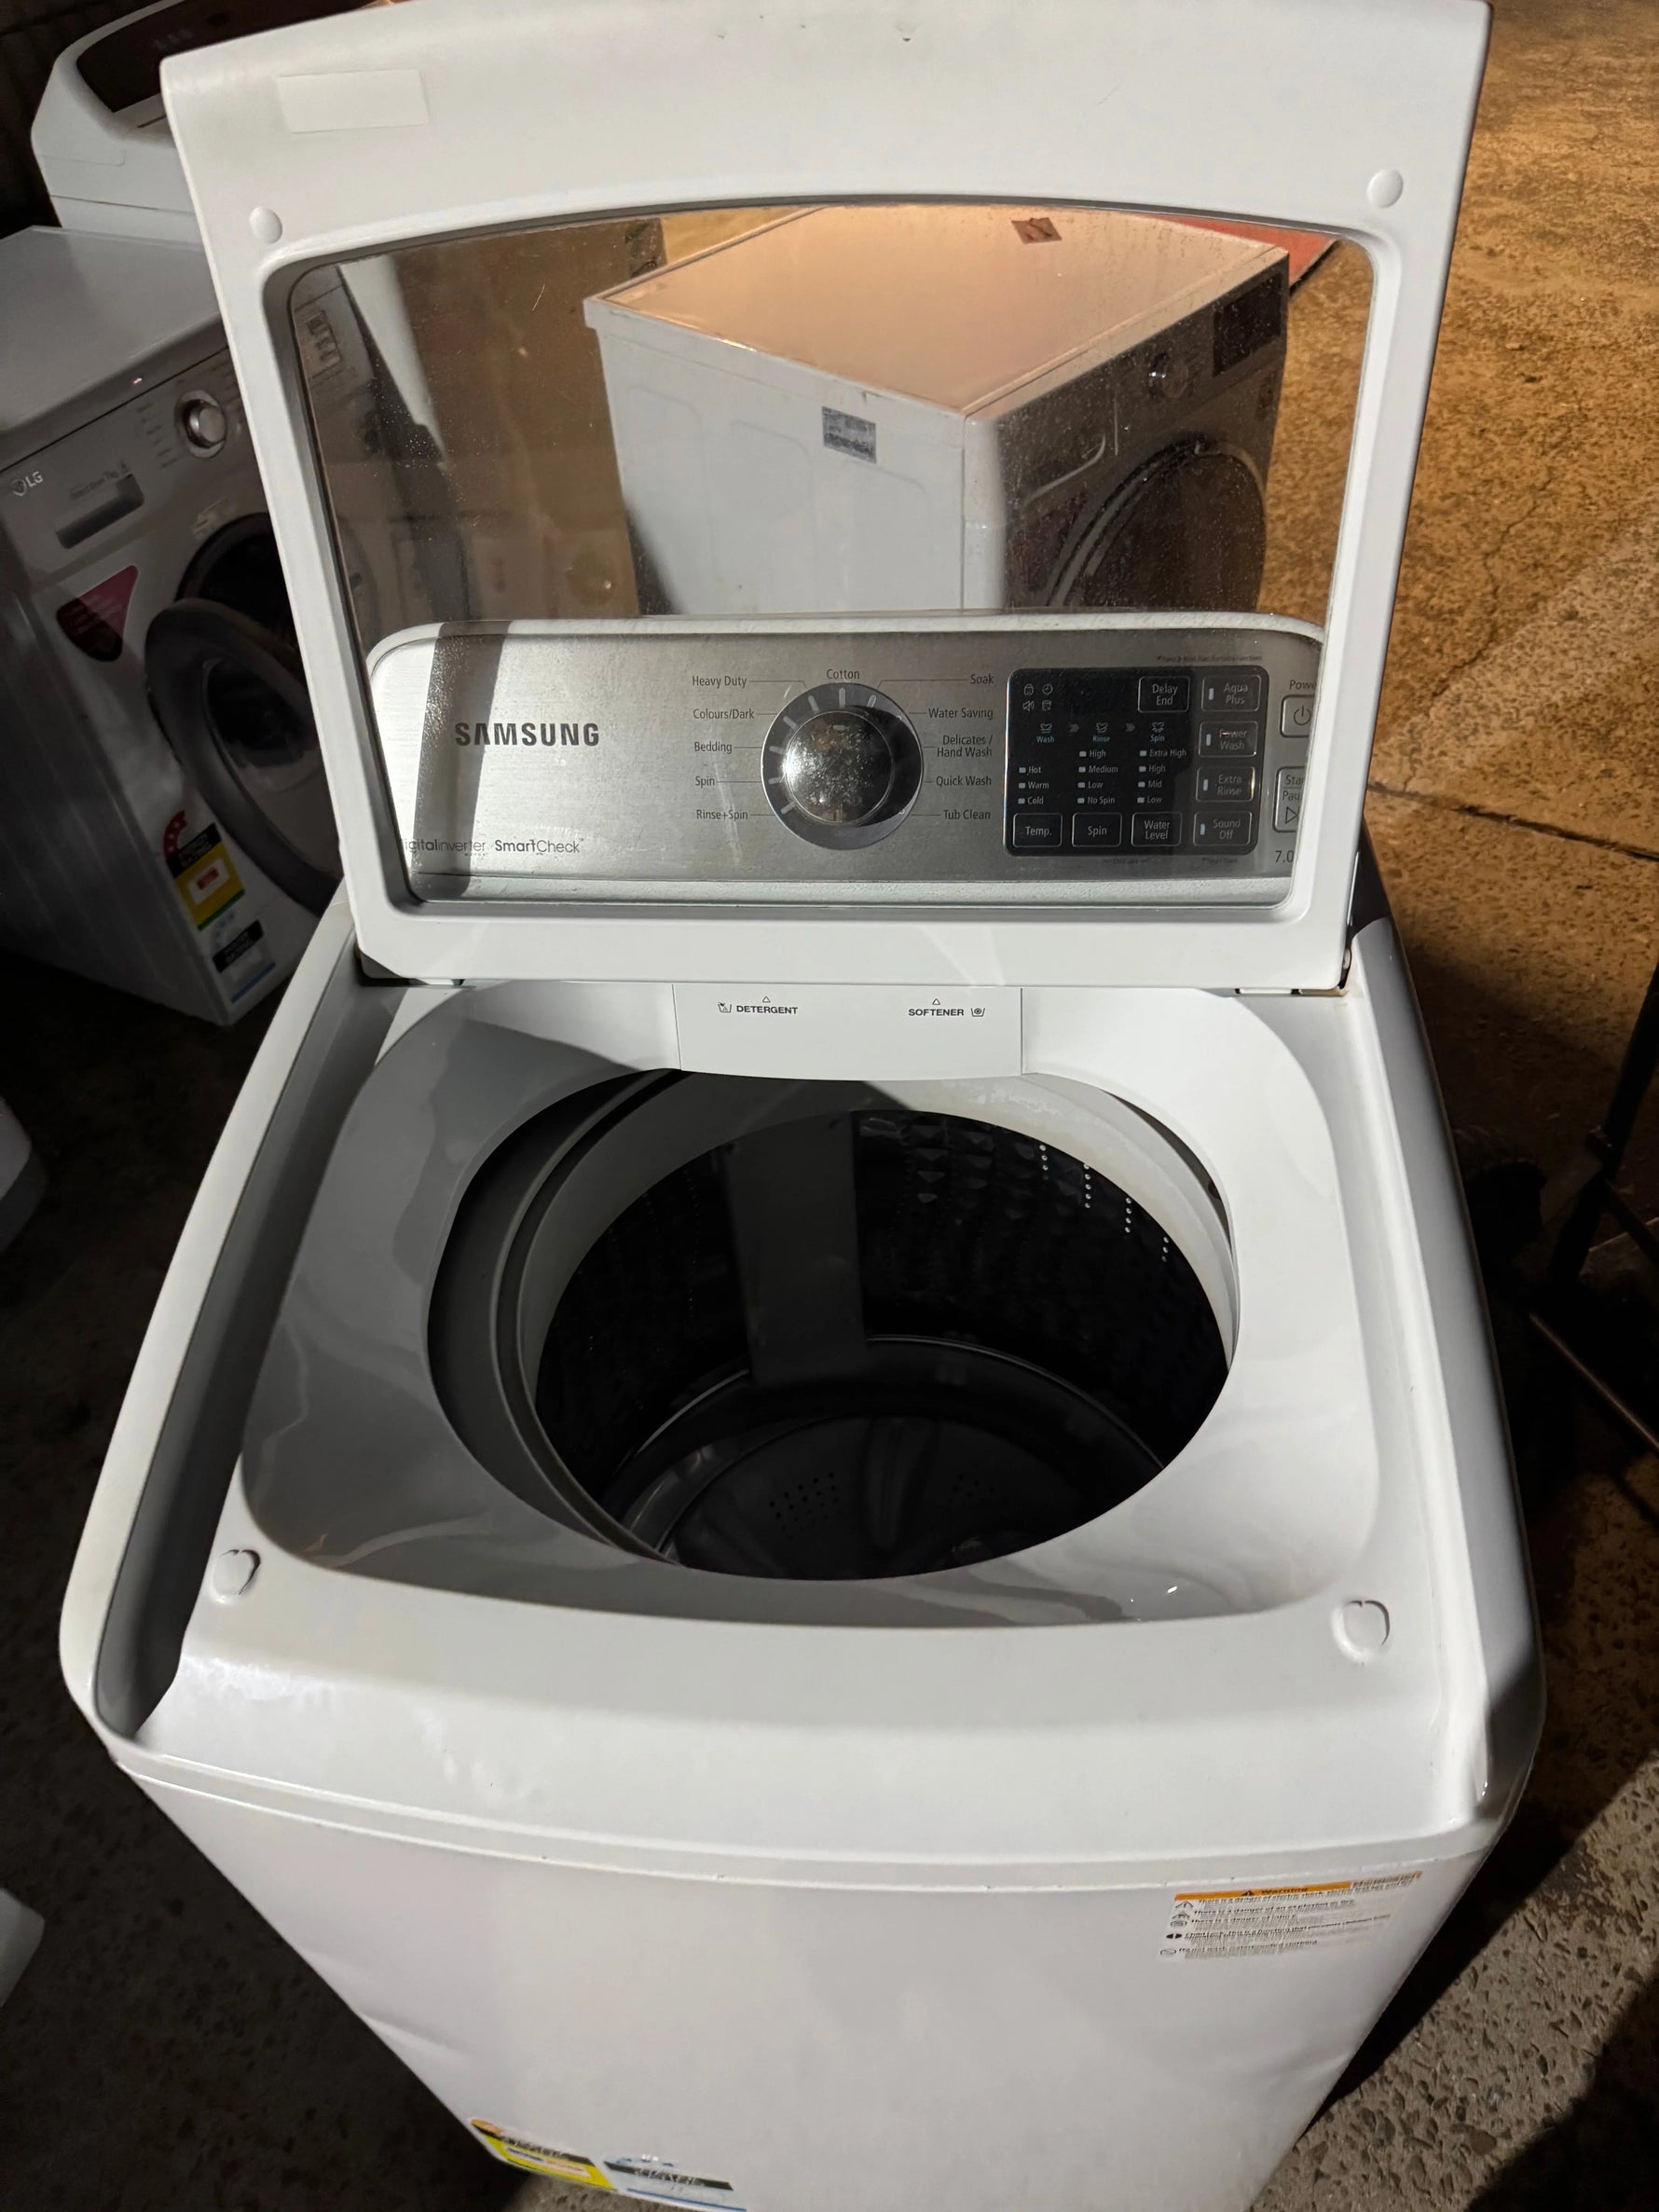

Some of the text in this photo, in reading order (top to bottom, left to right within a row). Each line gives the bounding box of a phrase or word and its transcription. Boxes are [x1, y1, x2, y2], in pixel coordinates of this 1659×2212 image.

[25, 471, 44, 488] LG
[826, 668, 860, 680] Cotton
[970, 674, 994, 684] Soak
[692, 675, 747, 688] Heavy Duty
[1289, 679, 1316, 690] Powe
[1151, 683, 1178, 695] Delay
[1223, 683, 1249, 694] Aqua
[1156, 695, 1173, 706] End
[1226, 695, 1246, 705] Plus
[692, 708, 755, 720] Colours/Dark
[928, 708, 994, 721] Water Saving
[455, 722, 599, 747] SAMSUNG
[1219, 729, 1248, 738] Power
[942, 735, 986, 745] Delicates
[1092, 735, 1110, 743] Rinse
[1150, 735, 1165, 744] Spin
[694, 741, 733, 754] Bedding
[1220, 740, 1245, 750] Wash
[937, 747, 993, 758] Hand Wash
[1089, 749, 1106, 759] High
[1149, 749, 1186, 758] Extra High
[1028, 765, 1042, 774] Hot
[1089, 765, 1118, 774] Medium
[1148, 765, 1166, 775] High
[694, 776, 716, 789] Spin
[936, 776, 992, 787] Quick Wash
[1218, 775, 1242, 784] Extra
[1286, 775, 1303, 785] Sta
[1027, 781, 1049, 790] Warm
[1088, 781, 1104, 790] Low
[1217, 785, 1242, 795] Rinse
[1027, 796, 1044, 804] Cold
[1087, 796, 1116, 805] No Spin
[1282, 790, 1301, 801] Pau
[696, 809, 748, 822] Rinse+Spin
[943, 809, 991, 820] Tub Clean
[1144, 820, 1171, 830] Water
[1213, 817, 1241, 829] Sound
[1025, 826, 1052, 837] Temp.
[1088, 825, 1107, 837] Spin
[1145, 830, 1169, 840] Level
[1219, 829, 1234, 840] Off
[404, 838, 581, 854] igitalinverter SmartCheck
[1275, 849, 1295, 863] 7.0
[736, 1005, 799, 1014] DETERGENT
[908, 1009, 965, 1017] SOFTENER
